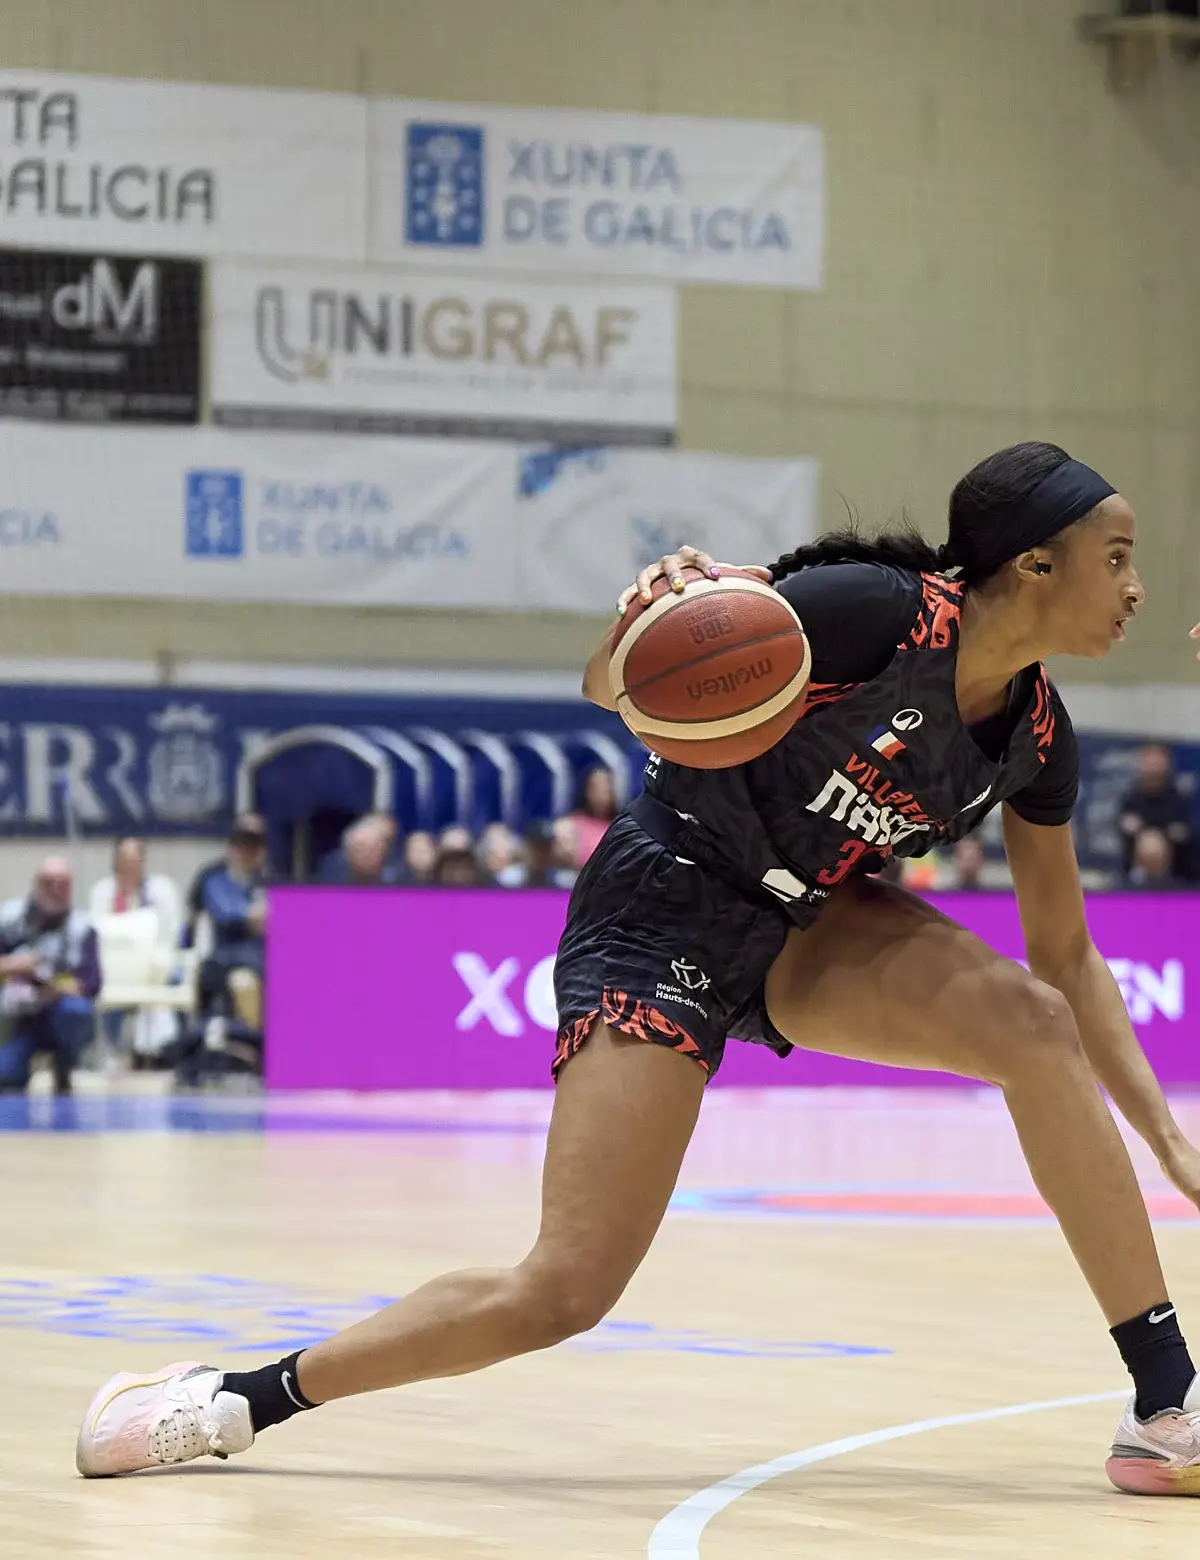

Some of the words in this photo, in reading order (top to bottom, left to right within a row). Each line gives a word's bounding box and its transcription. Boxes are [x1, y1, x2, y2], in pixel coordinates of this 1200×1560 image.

[506, 138, 686, 195] XUNTA
[0, 156, 217, 226] ALICIA
[503, 194, 570, 247] DE
[582, 198, 792, 256] GALICIA
[256, 285, 641, 384] UNIGRAF
[261, 478, 392, 516] XUNTA
[256, 517, 305, 553] DE
[314, 520, 472, 562] GALICIA
[689, 614, 736, 645] FIBA
[685, 657, 773, 702] molten
[656, 983, 681, 994] Région
